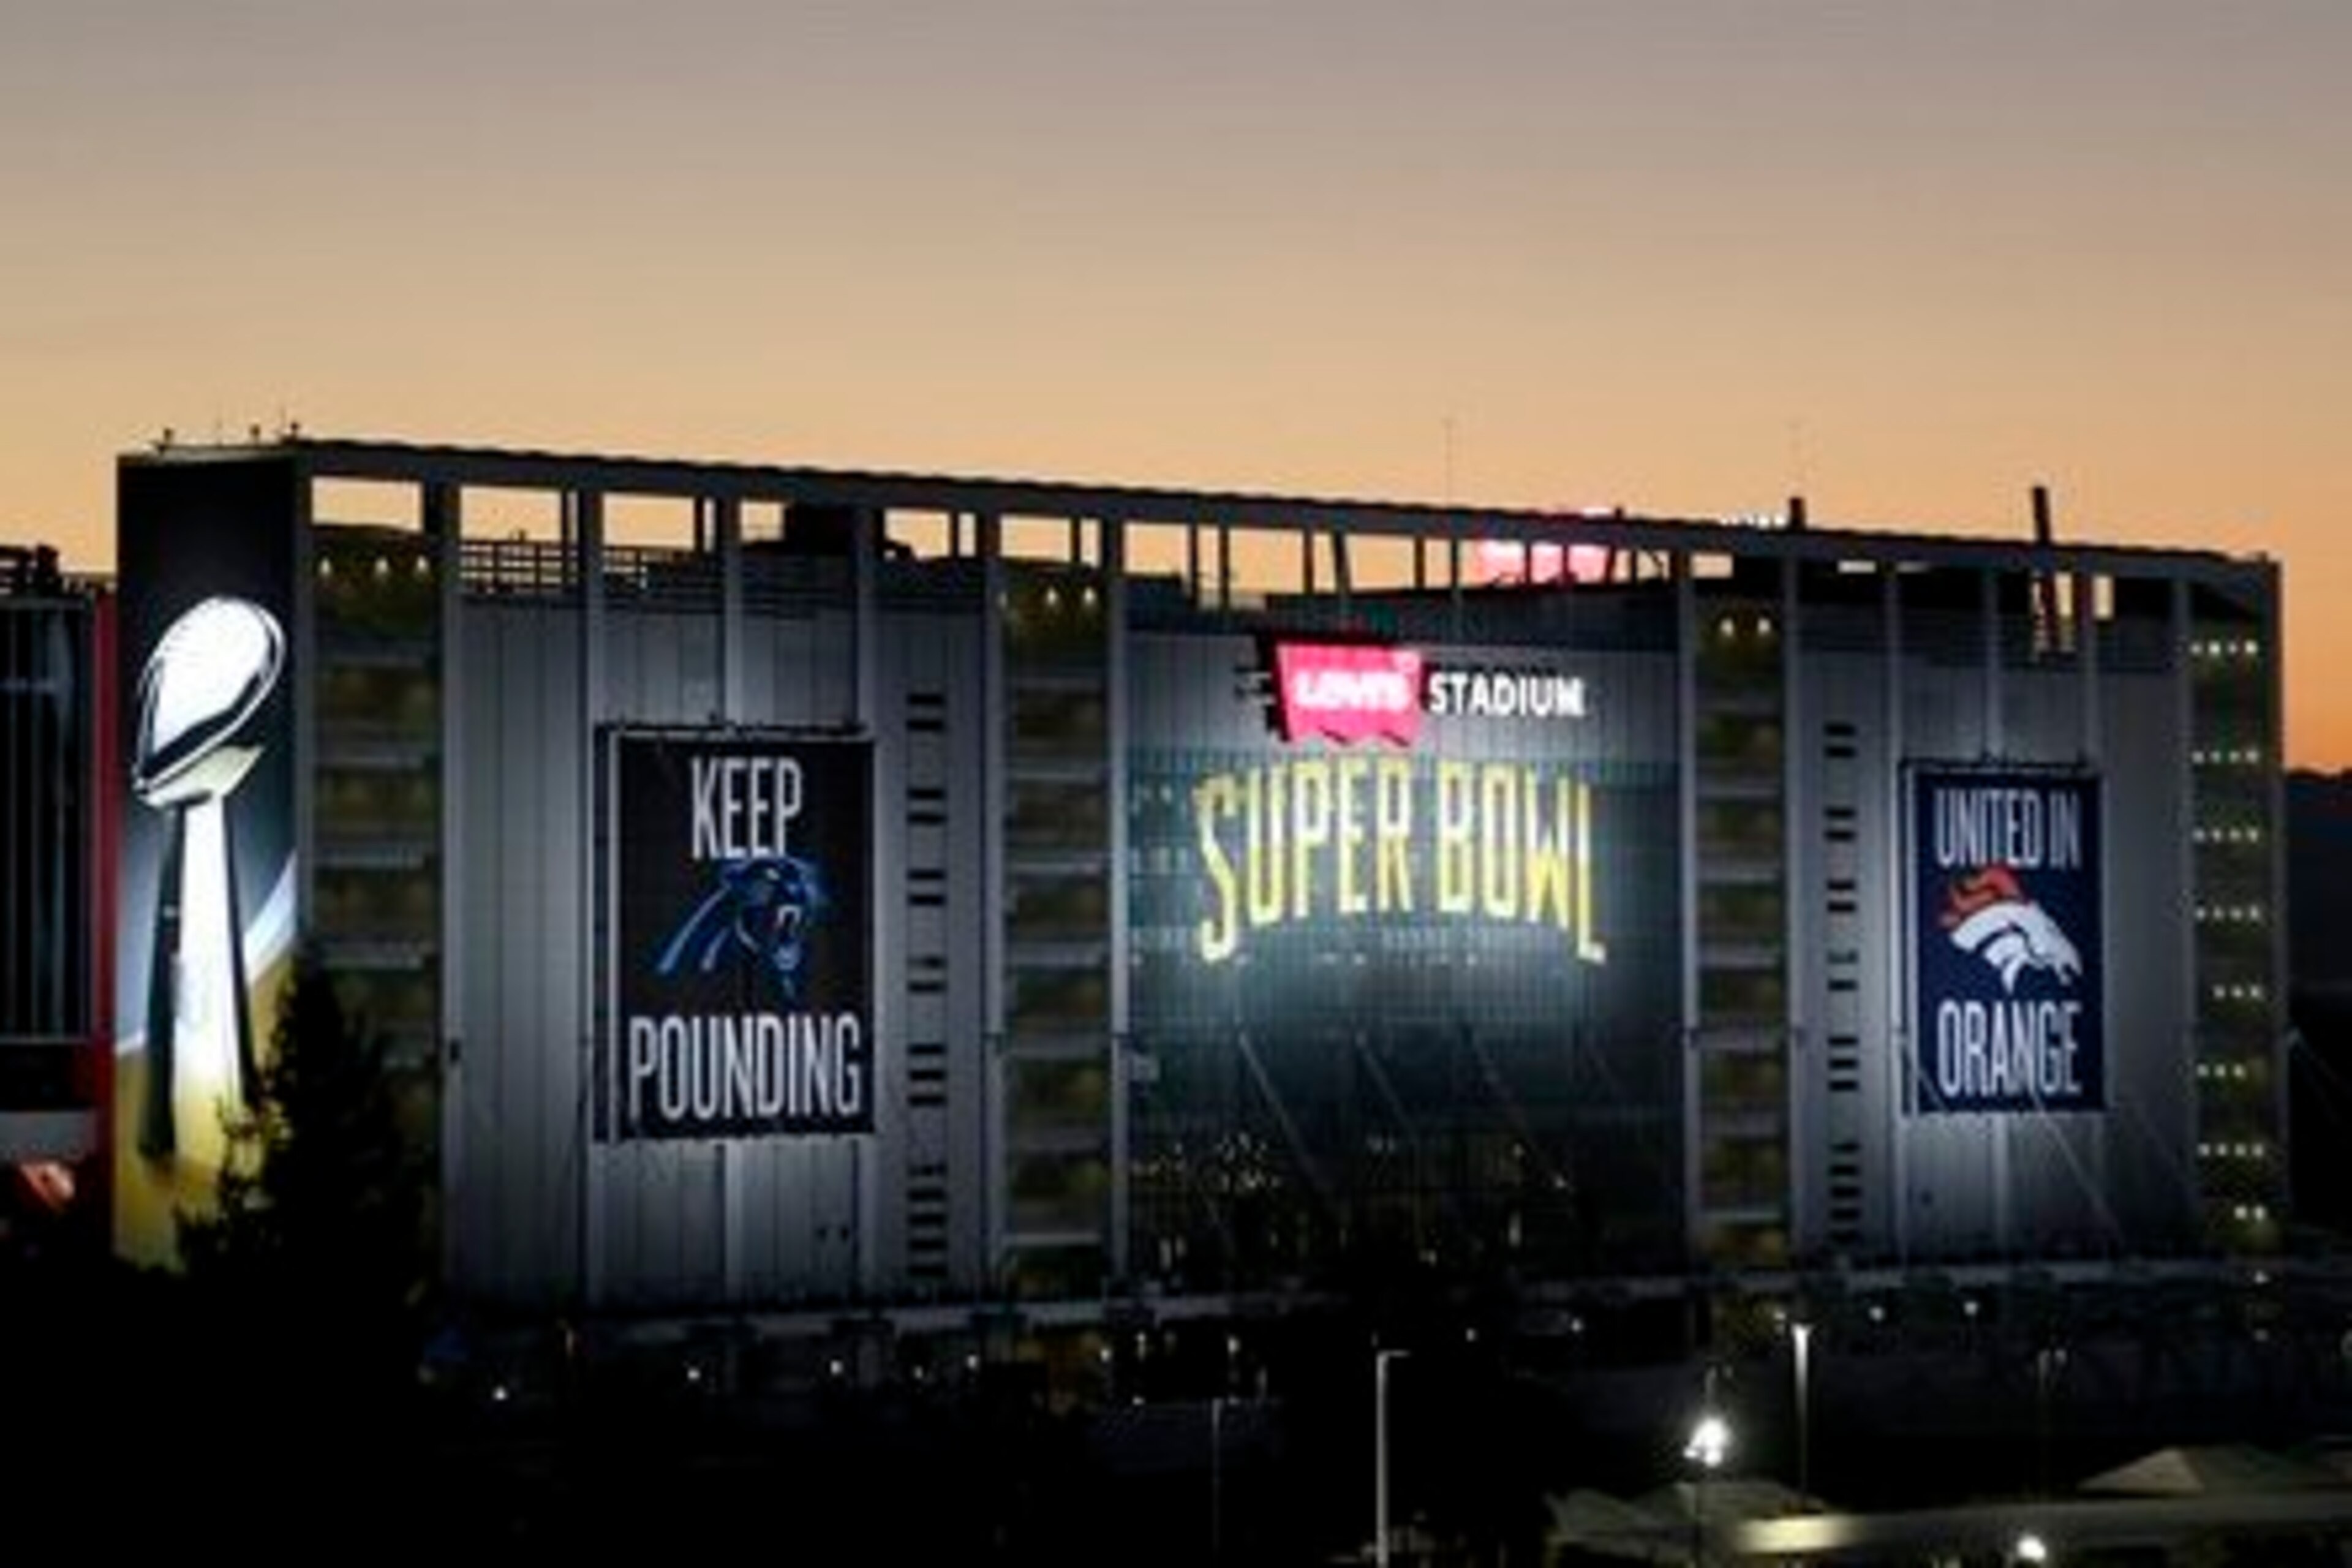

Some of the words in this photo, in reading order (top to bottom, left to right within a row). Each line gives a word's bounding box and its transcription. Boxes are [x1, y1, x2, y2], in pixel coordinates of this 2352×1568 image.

[1429, 673, 1586, 717] STADIUM
[690, 755, 802, 859] KEEP
[1934, 789, 2042, 867] UNITED
[2048, 789, 2081, 867] IN
[1193, 758, 1415, 962] SUPER
[1437, 758, 1606, 963] BOWL
[628, 1012, 862, 1120] POUNDING
[1937, 1001, 2082, 1098] ORANGE
